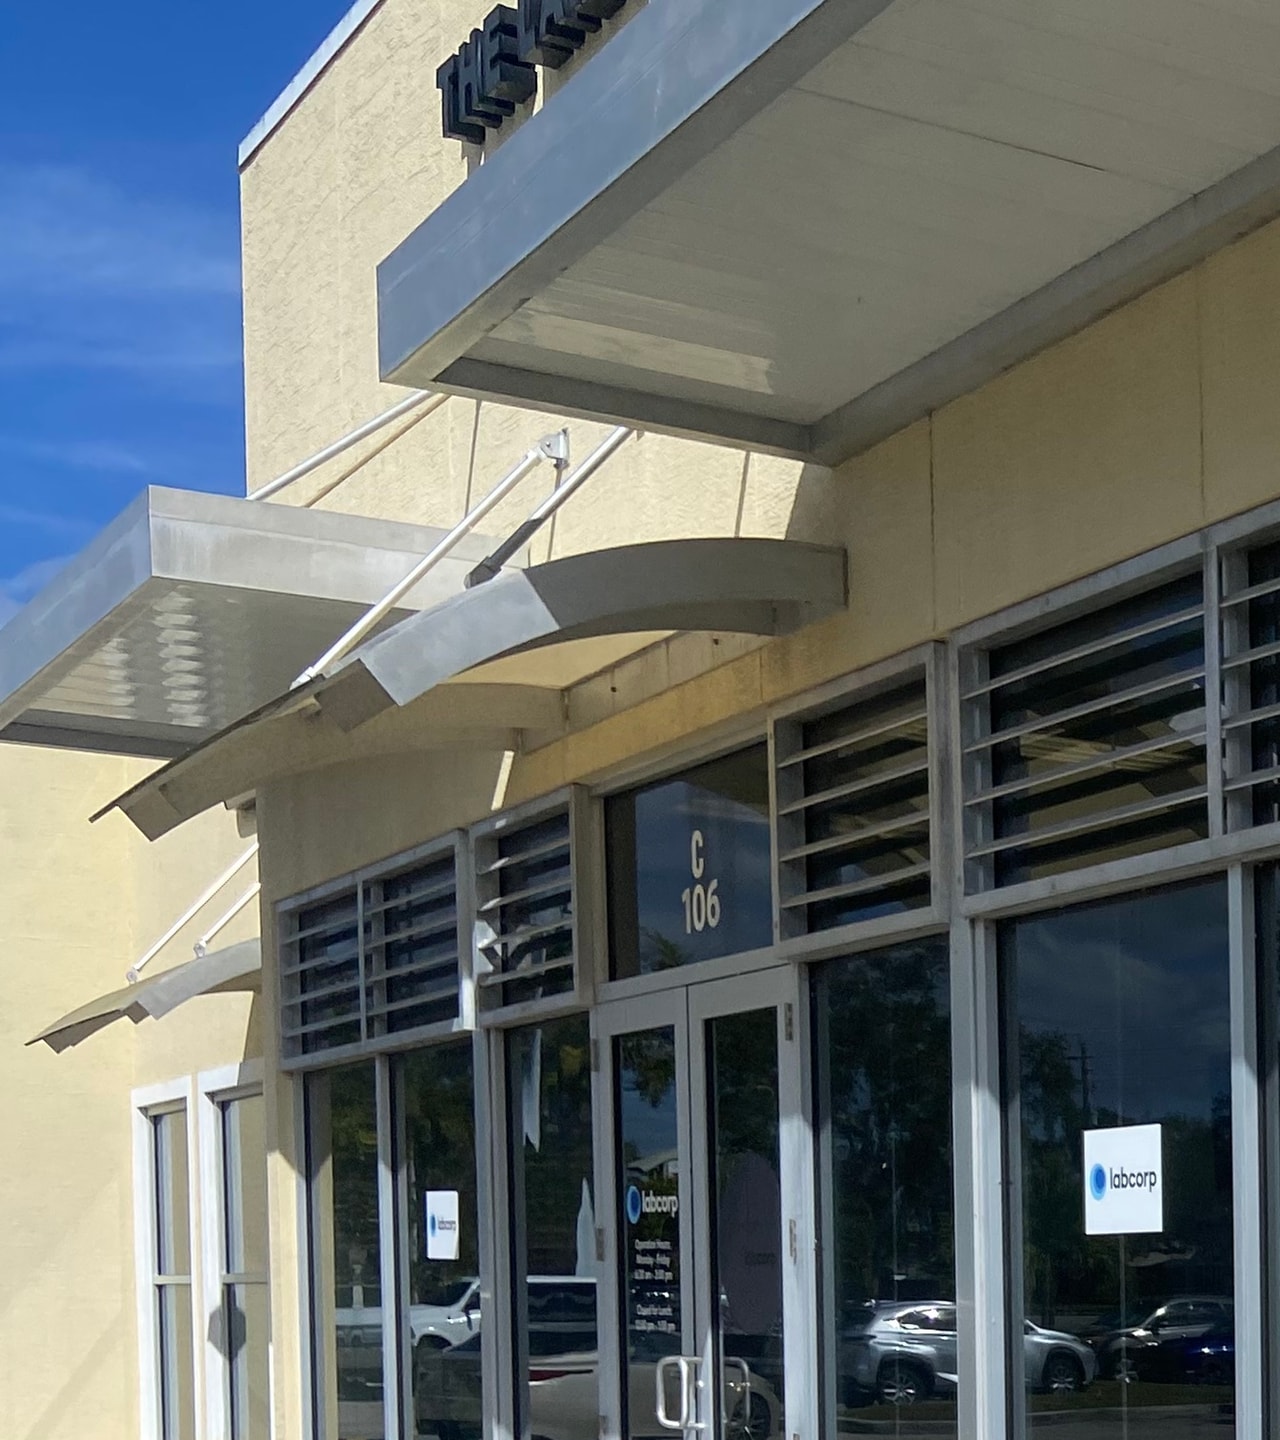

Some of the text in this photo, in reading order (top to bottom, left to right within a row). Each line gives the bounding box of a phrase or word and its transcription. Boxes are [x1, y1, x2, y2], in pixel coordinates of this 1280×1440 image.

[690, 829, 705, 880] C
[681, 878, 721, 934] 106
[1109, 1166, 1157, 1193] labcorp
[641, 1190, 679, 1218] labcorp
